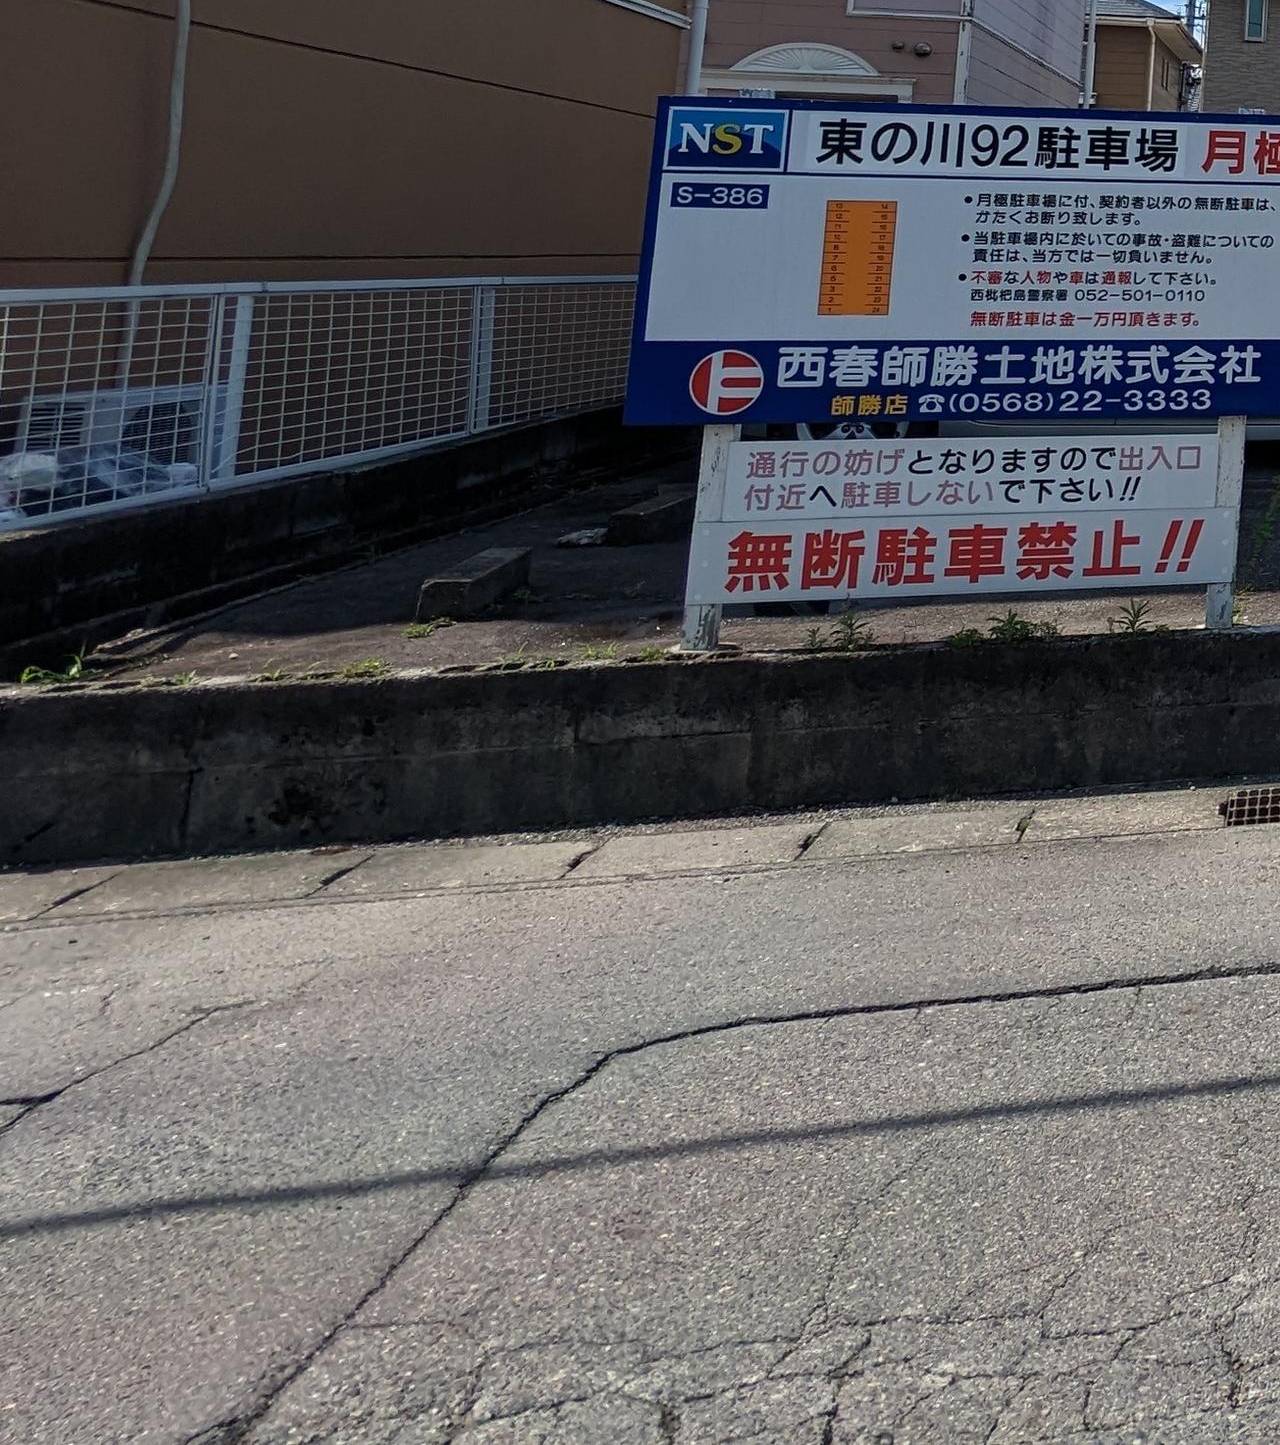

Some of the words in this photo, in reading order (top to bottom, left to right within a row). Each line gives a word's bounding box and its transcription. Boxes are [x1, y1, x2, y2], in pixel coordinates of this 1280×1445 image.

[678, 122, 774, 154] NST
[815, 118, 1179, 173] 東の川92駐車場
[676, 186, 763, 205] S-386
[975, 211, 1141, 226] かたくお断り致します。
[972, 249, 1213, 265] 責任は、当方では一切負いません。
[970, 270, 1217, 286] 不審な人物や車は通報して下さい。
[1074, 288, 1206, 302] 052-501-0110
[970, 311, 1200, 328] 無断駐車は金一万円頂きます。
[776, 345, 1262, 387] 西春師勝土地株式会社
[831, 394, 908, 416] 師勝店
[949, 389, 1212, 413] (0568)22-3333
[746, 446, 1201, 479] 通行の妨げとなりますので出入口
